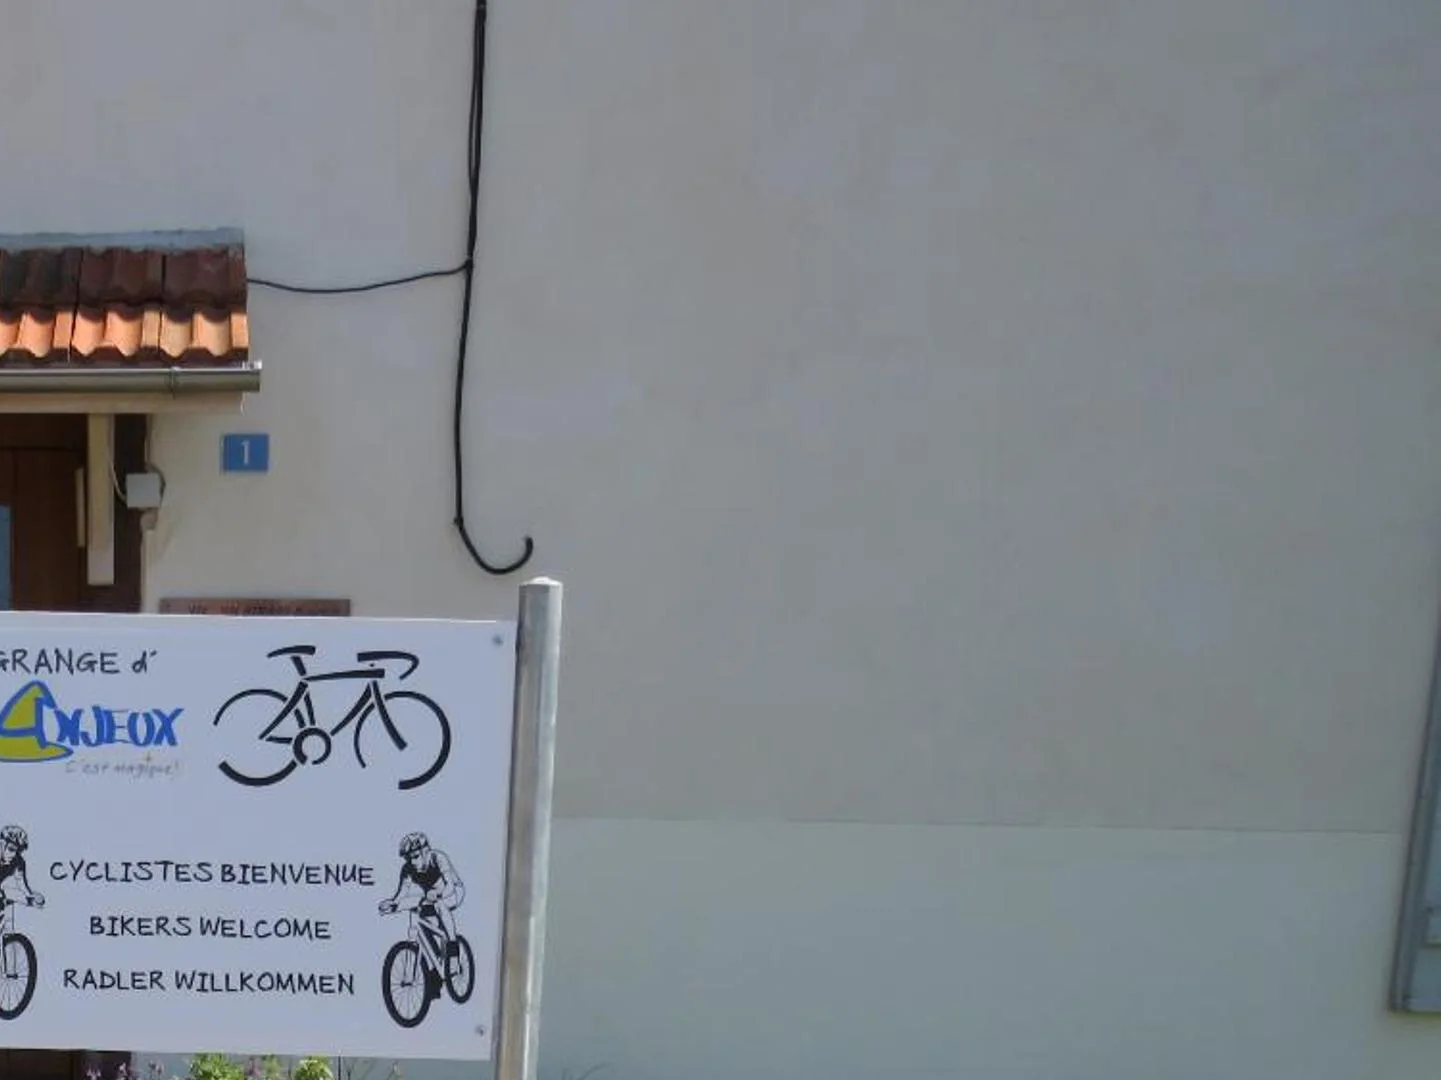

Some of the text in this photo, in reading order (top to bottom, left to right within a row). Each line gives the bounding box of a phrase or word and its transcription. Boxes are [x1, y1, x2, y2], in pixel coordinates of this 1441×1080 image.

[240, 440, 251, 466] 1
[49, 860, 376, 886] CYCLISTES BIENVENUE
[89, 915, 332, 940] BIKERS WELCOME
[63, 969, 355, 995] RADLER WILLKOMMEN
